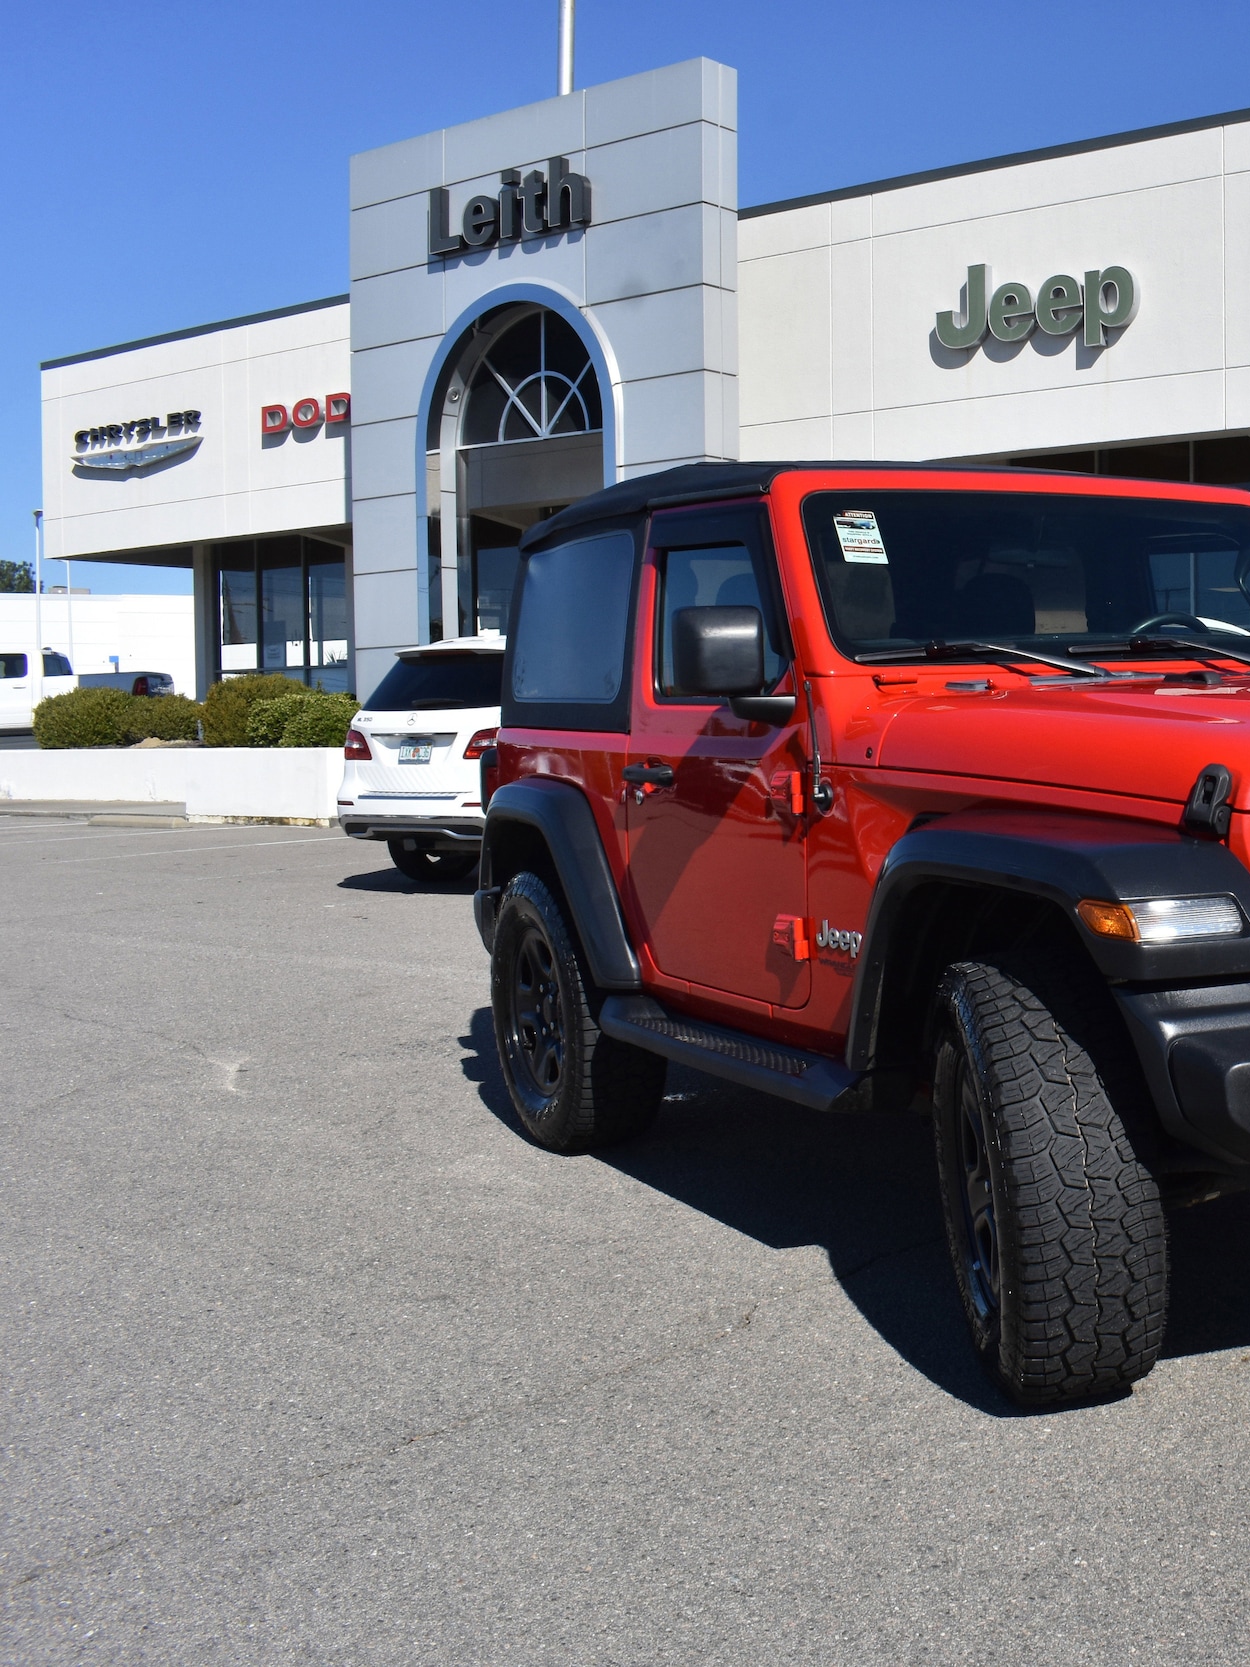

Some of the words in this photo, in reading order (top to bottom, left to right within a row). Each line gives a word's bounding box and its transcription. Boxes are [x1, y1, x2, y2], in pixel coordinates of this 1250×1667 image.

[429, 156, 592, 255] Leith
[935, 263, 1141, 349] Jeep
[74, 409, 202, 446] CHRYSLER
[816, 919, 863, 959] Jeep
